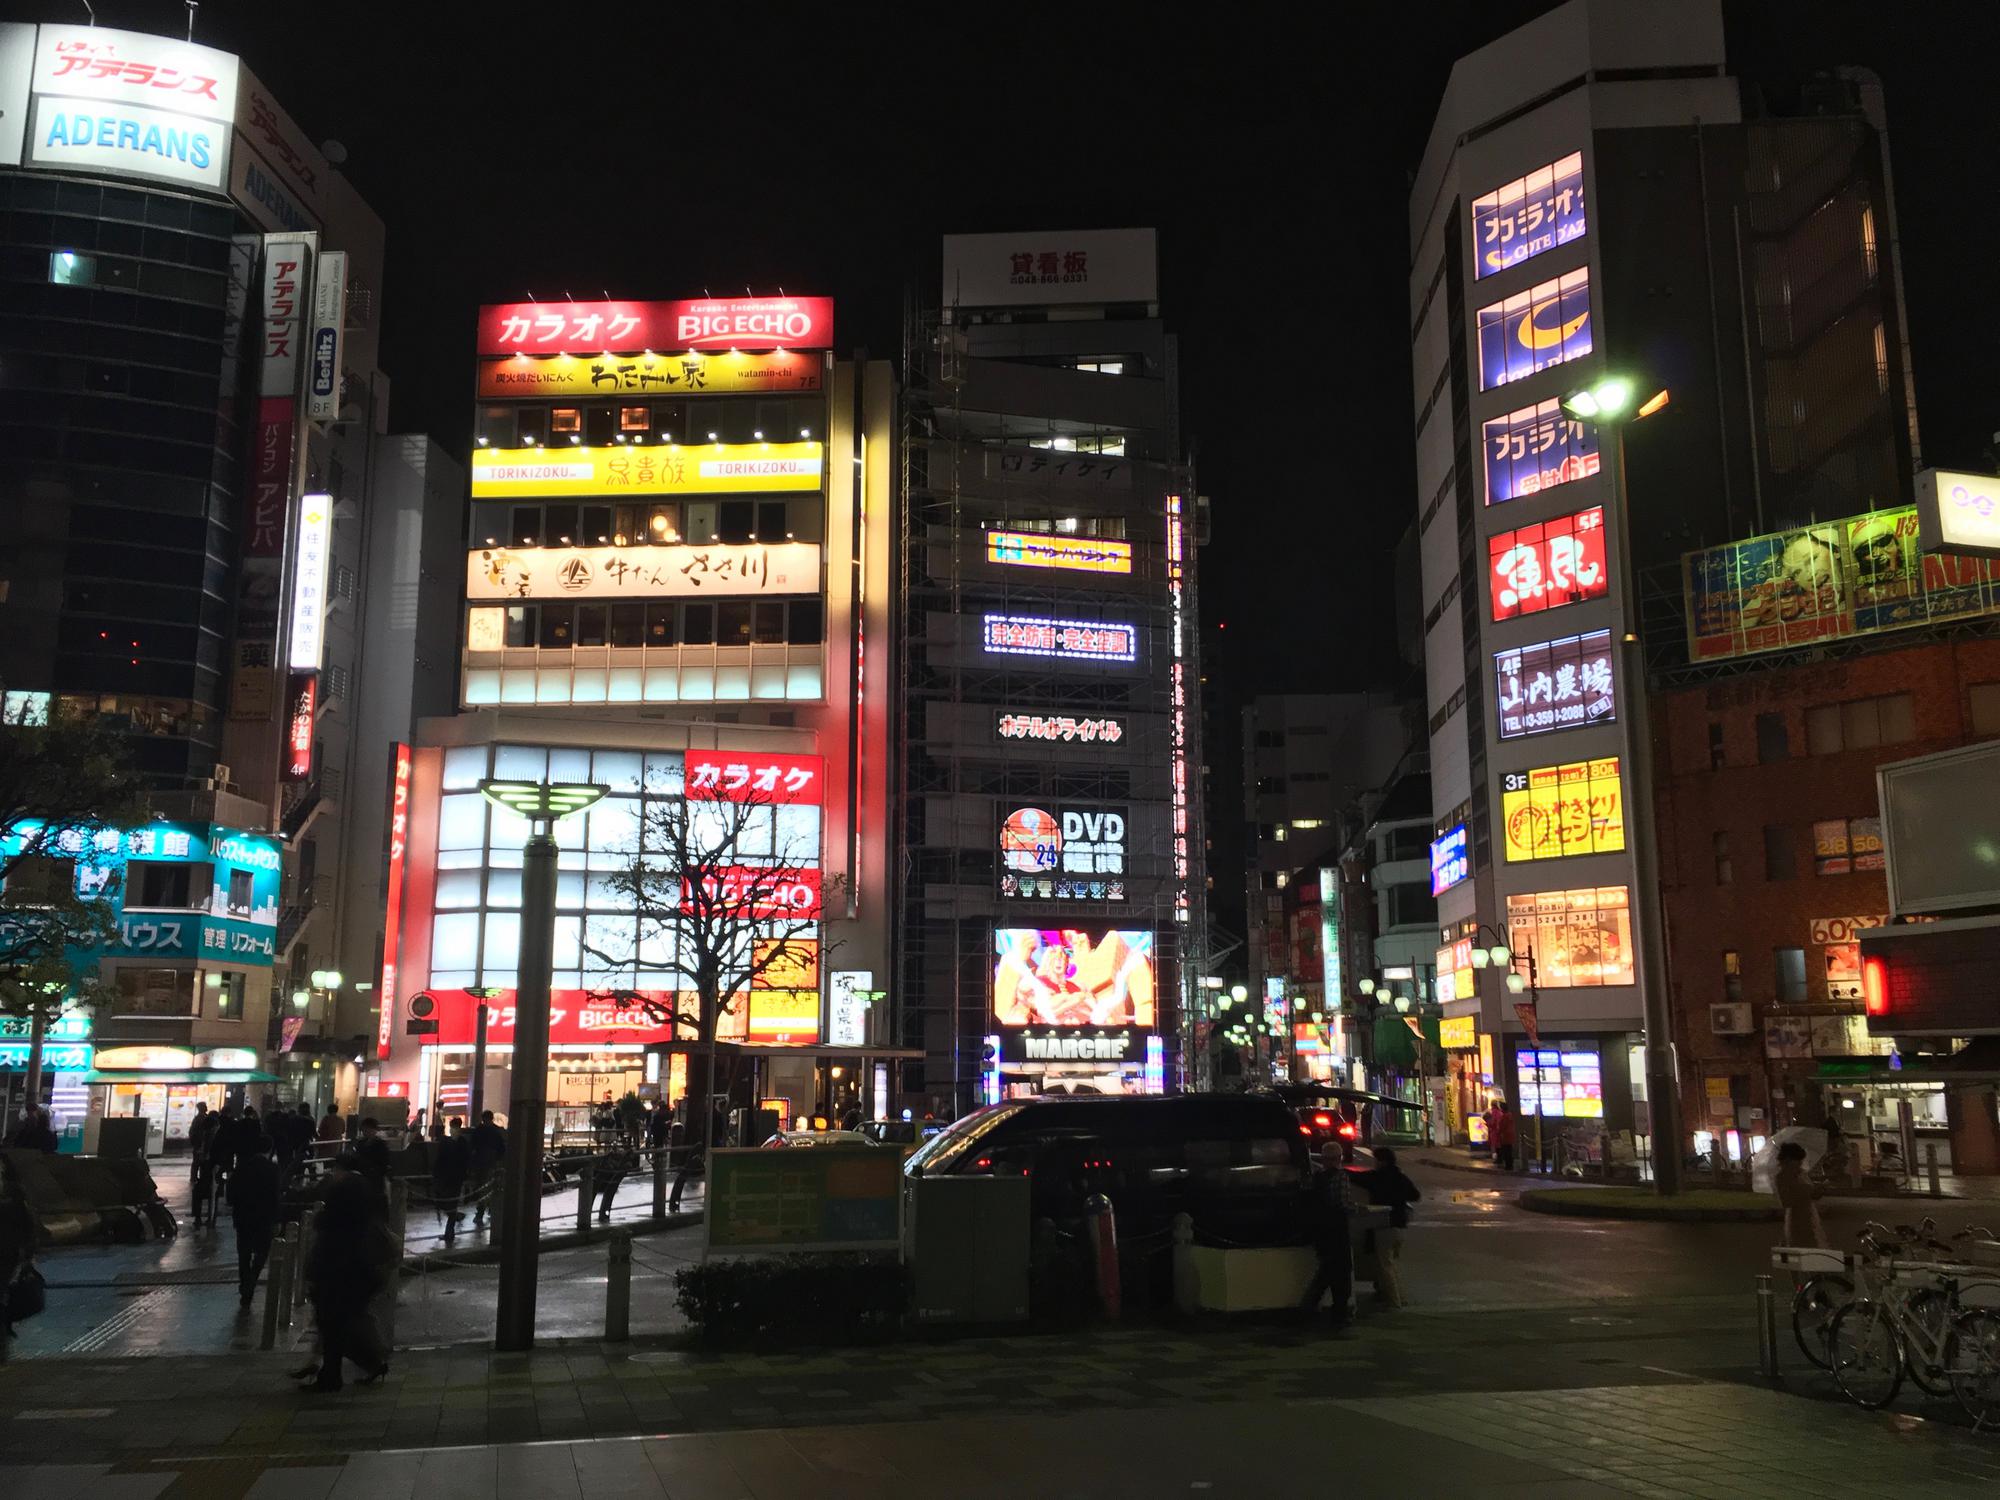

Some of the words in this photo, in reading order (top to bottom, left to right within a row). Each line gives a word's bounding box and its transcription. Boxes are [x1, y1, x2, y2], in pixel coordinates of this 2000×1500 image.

[52, 55, 219, 101] アデランス
[47, 112, 211, 169] ADERANS
[1514, 231, 1552, 259] COTE
[1009, 251, 1088, 274] 貸看板
[267, 261, 298, 358] アデランス
[498, 313, 641, 344] カラオケ
[677, 315, 730, 341] BIG
[735, 312, 811, 338] ECHO
[315, 333, 333, 390] Berlitz
[590, 359, 709, 390] わたみん家
[737, 368, 793, 379] watamin-chi
[495, 371, 575, 384] 炭火焼だいにんぐ
[312, 402, 331, 414] 8F
[490, 466, 570, 480] TORIKIZOKU
[605, 456, 686, 486] 鳥貴族
[717, 461, 799, 475] TORIKIZOKU
[251, 482, 280, 548] アビバ
[1578, 511, 1601, 532] 5F
[1495, 534, 1604, 608] 魚民
[1501, 656, 1522, 675] 4F
[1501, 657, 1613, 711] 山内農場
[1504, 715, 1523, 732] TEL
[691, 762, 814, 792] カラオケ
[1505, 774, 1528, 791] 3F
[391, 759, 409, 860] カラオケ
[1551, 792, 1617, 820] やきとり
[1062, 811, 1125, 842] DVD
[1555, 818, 1622, 845] センター
[1036, 843, 1057, 867] 24
[203, 927, 227, 949] 管理
[230, 932, 273, 956] リフォーム
[486, 1006, 568, 1028] カラケ
[578, 1010, 613, 1029] BIG
[615, 1009, 665, 1029] ECHO
[1025, 1038, 1125, 1059] MARCHE
